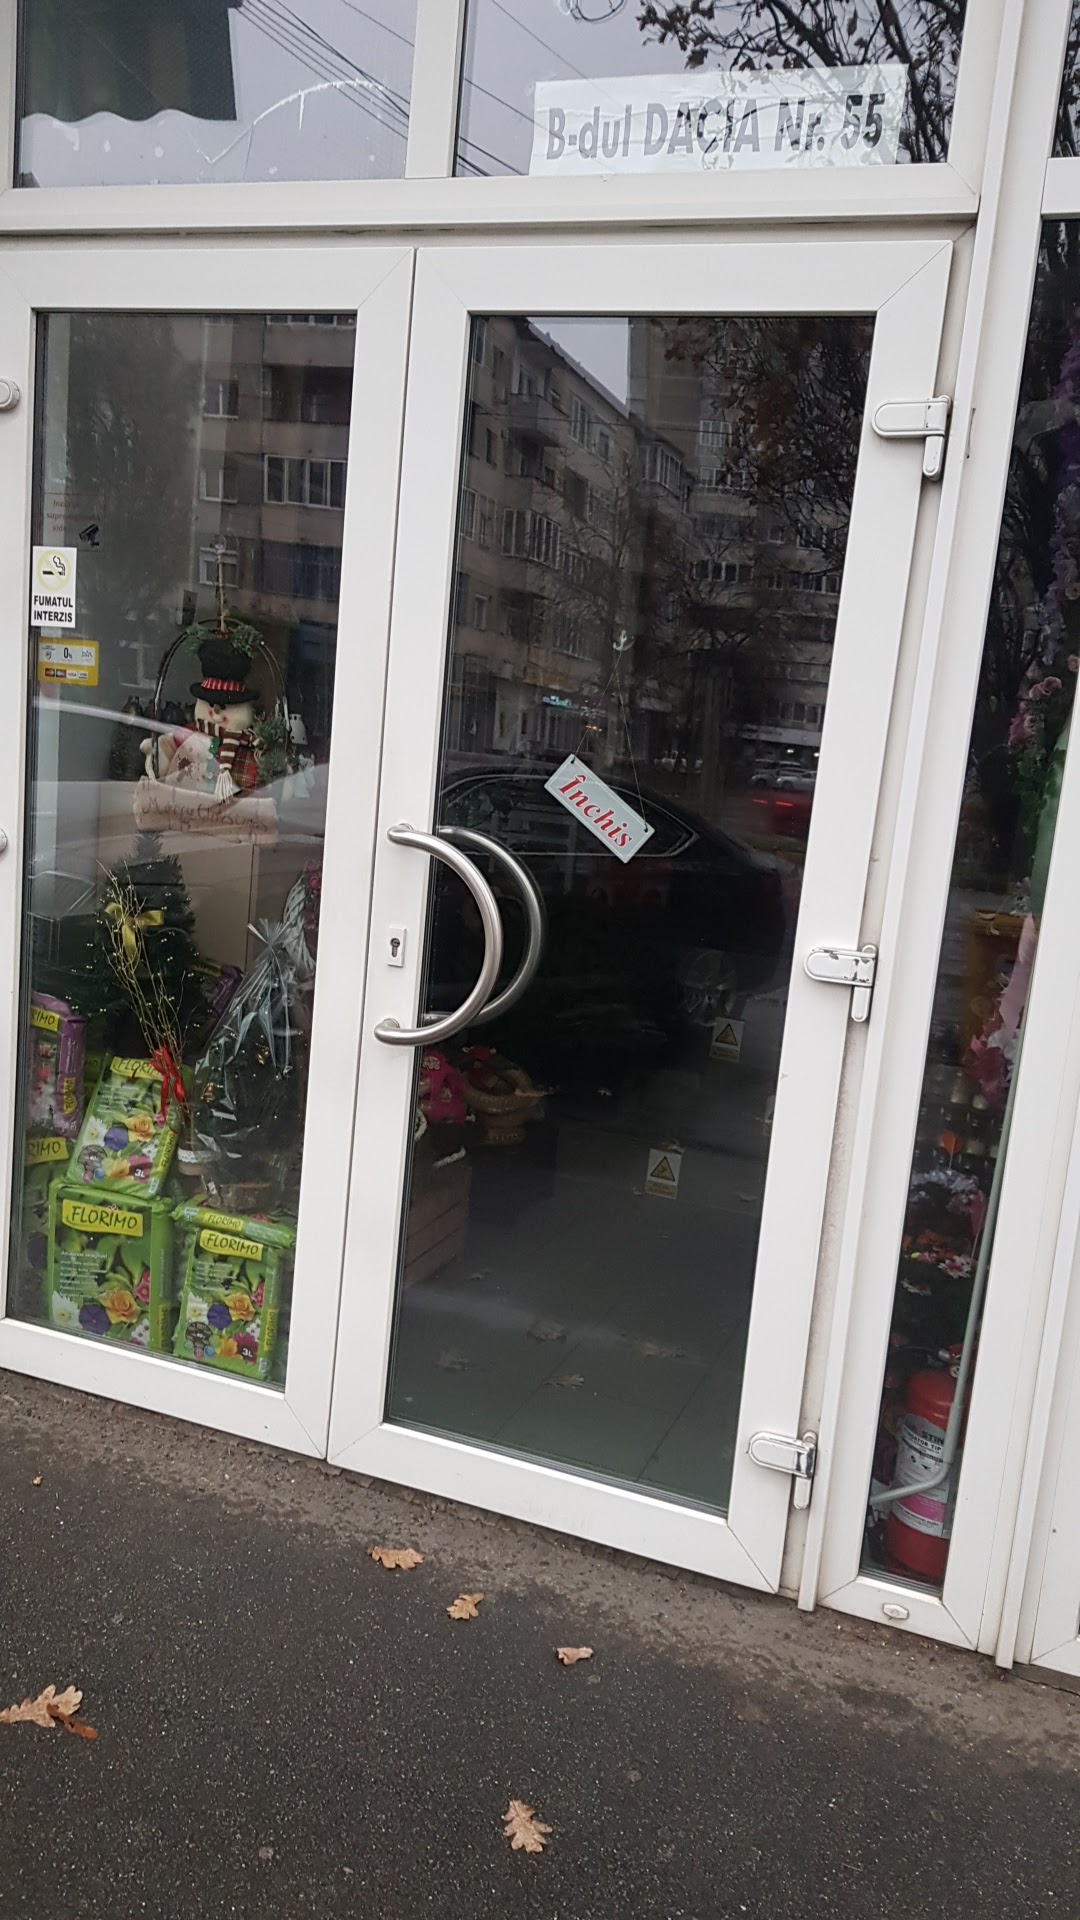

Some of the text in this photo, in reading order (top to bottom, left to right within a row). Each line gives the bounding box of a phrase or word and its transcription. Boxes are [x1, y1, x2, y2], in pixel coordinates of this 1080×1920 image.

[546, 93, 886, 160] B-dul DACIA Nr. 55
[33, 595, 73, 608] FUMATUL
[33, 610, 73, 623] INTERZIS
[558, 774, 632, 848] Închis
[134, 1168, 146, 1178] 3L
[71, 1205, 138, 1230] FLORIMO
[207, 1214, 241, 1229] FLORIMO
[206, 1233, 259, 1255] FLORIMO
[266, 1311, 277, 1347] FLORIMO
[242, 1347, 253, 1358] 3L
